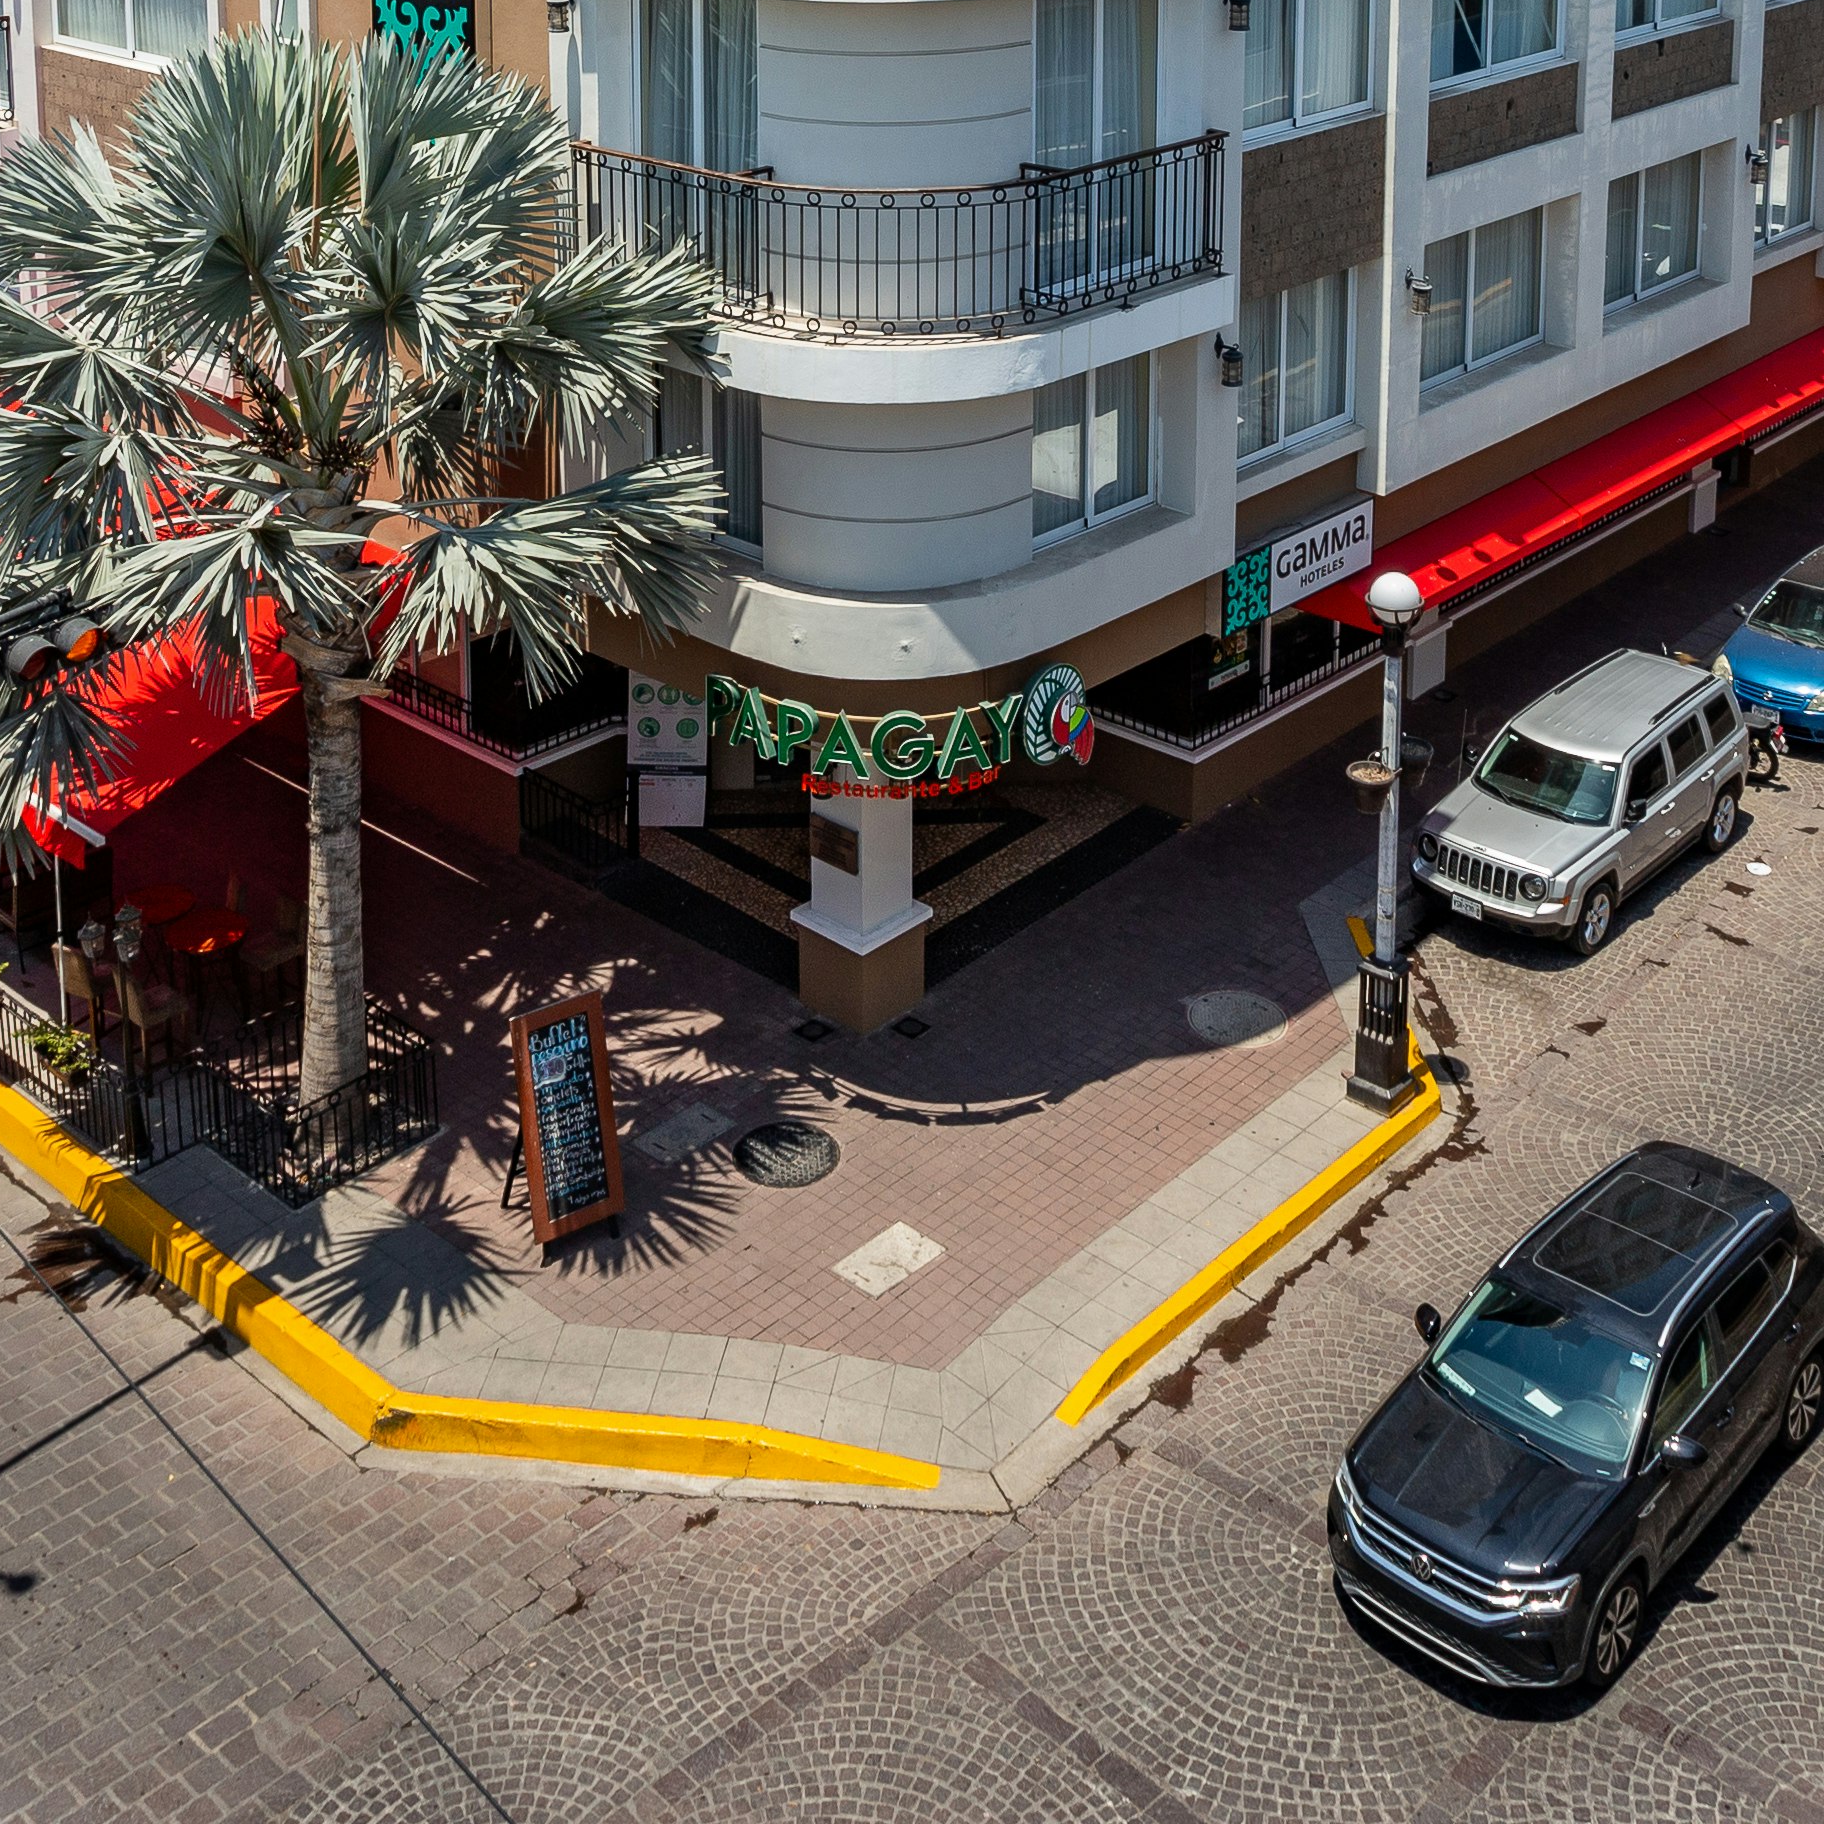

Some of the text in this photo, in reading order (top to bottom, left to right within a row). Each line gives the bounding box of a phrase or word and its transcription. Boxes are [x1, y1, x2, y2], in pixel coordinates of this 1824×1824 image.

[1300, 556, 1345, 588] HOTELES
[801, 773, 941, 800] Restaurante
[968, 766, 1001, 791] Bar
